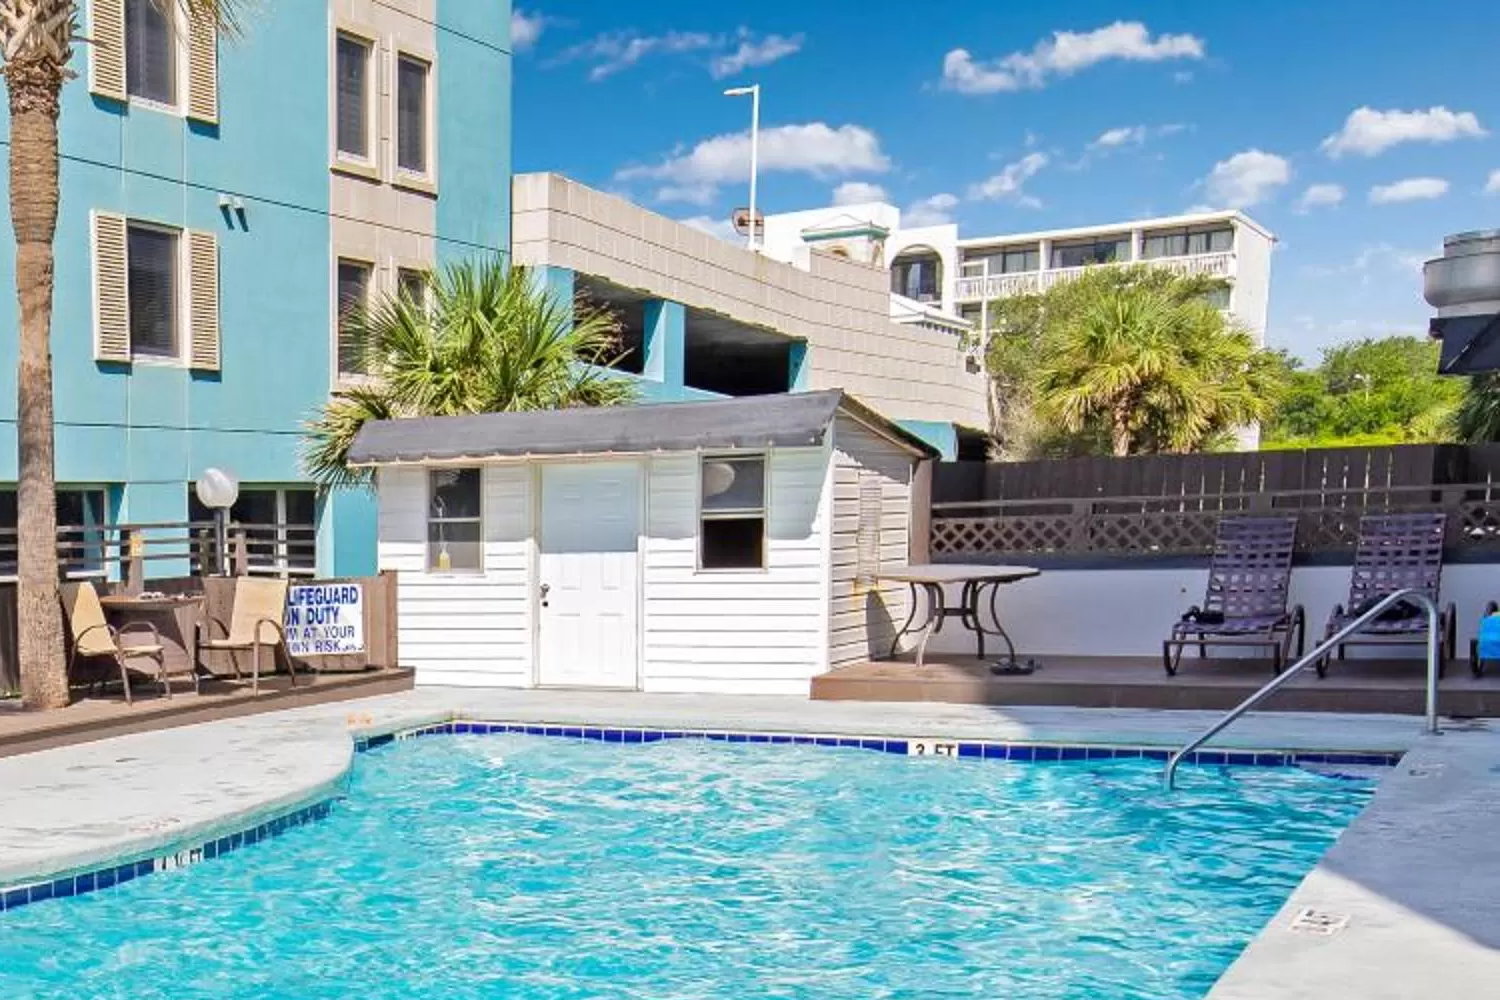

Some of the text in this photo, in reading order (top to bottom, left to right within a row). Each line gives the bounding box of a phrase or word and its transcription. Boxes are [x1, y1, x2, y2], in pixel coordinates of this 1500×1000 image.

[307, 606, 340, 624] DUTY
[303, 627, 317, 639] AT
[324, 625, 355, 639] YOUR
[315, 639, 341, 653] RISK
